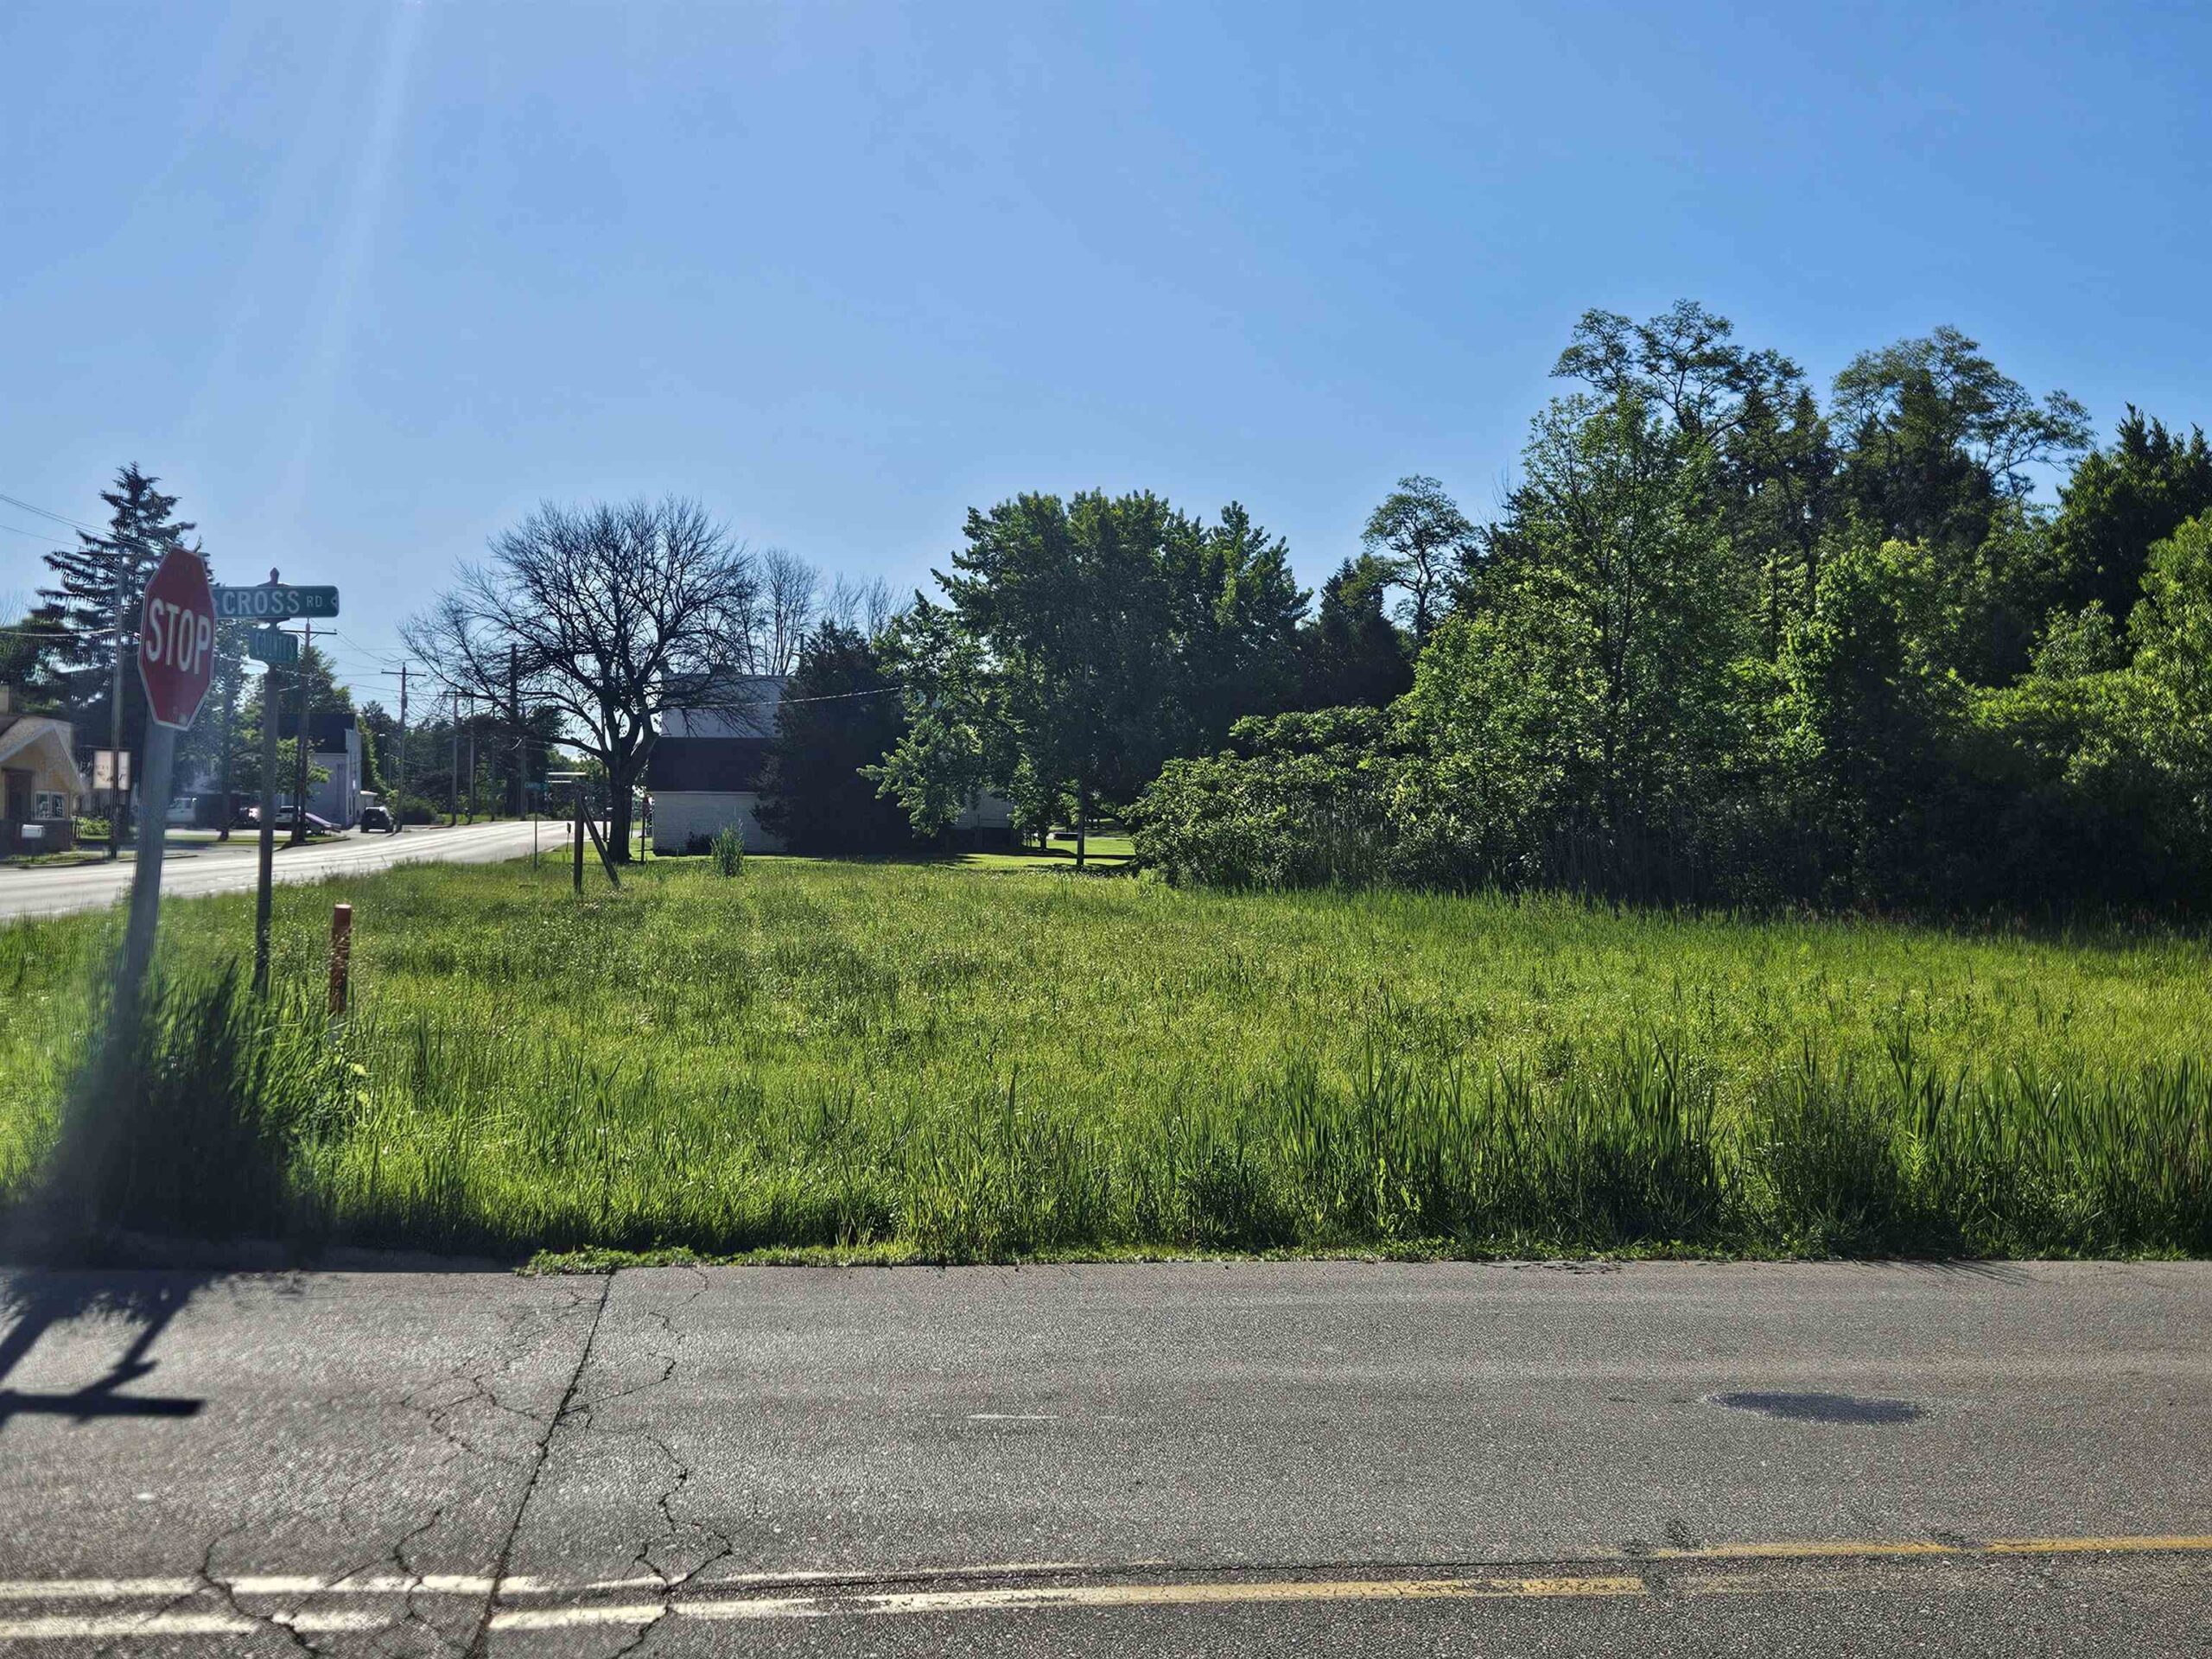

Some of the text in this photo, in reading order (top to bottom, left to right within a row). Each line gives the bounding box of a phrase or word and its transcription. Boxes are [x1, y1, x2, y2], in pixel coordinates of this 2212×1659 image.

[222, 590, 322, 614] CROSS RD
[145, 598, 212, 675] STOP
